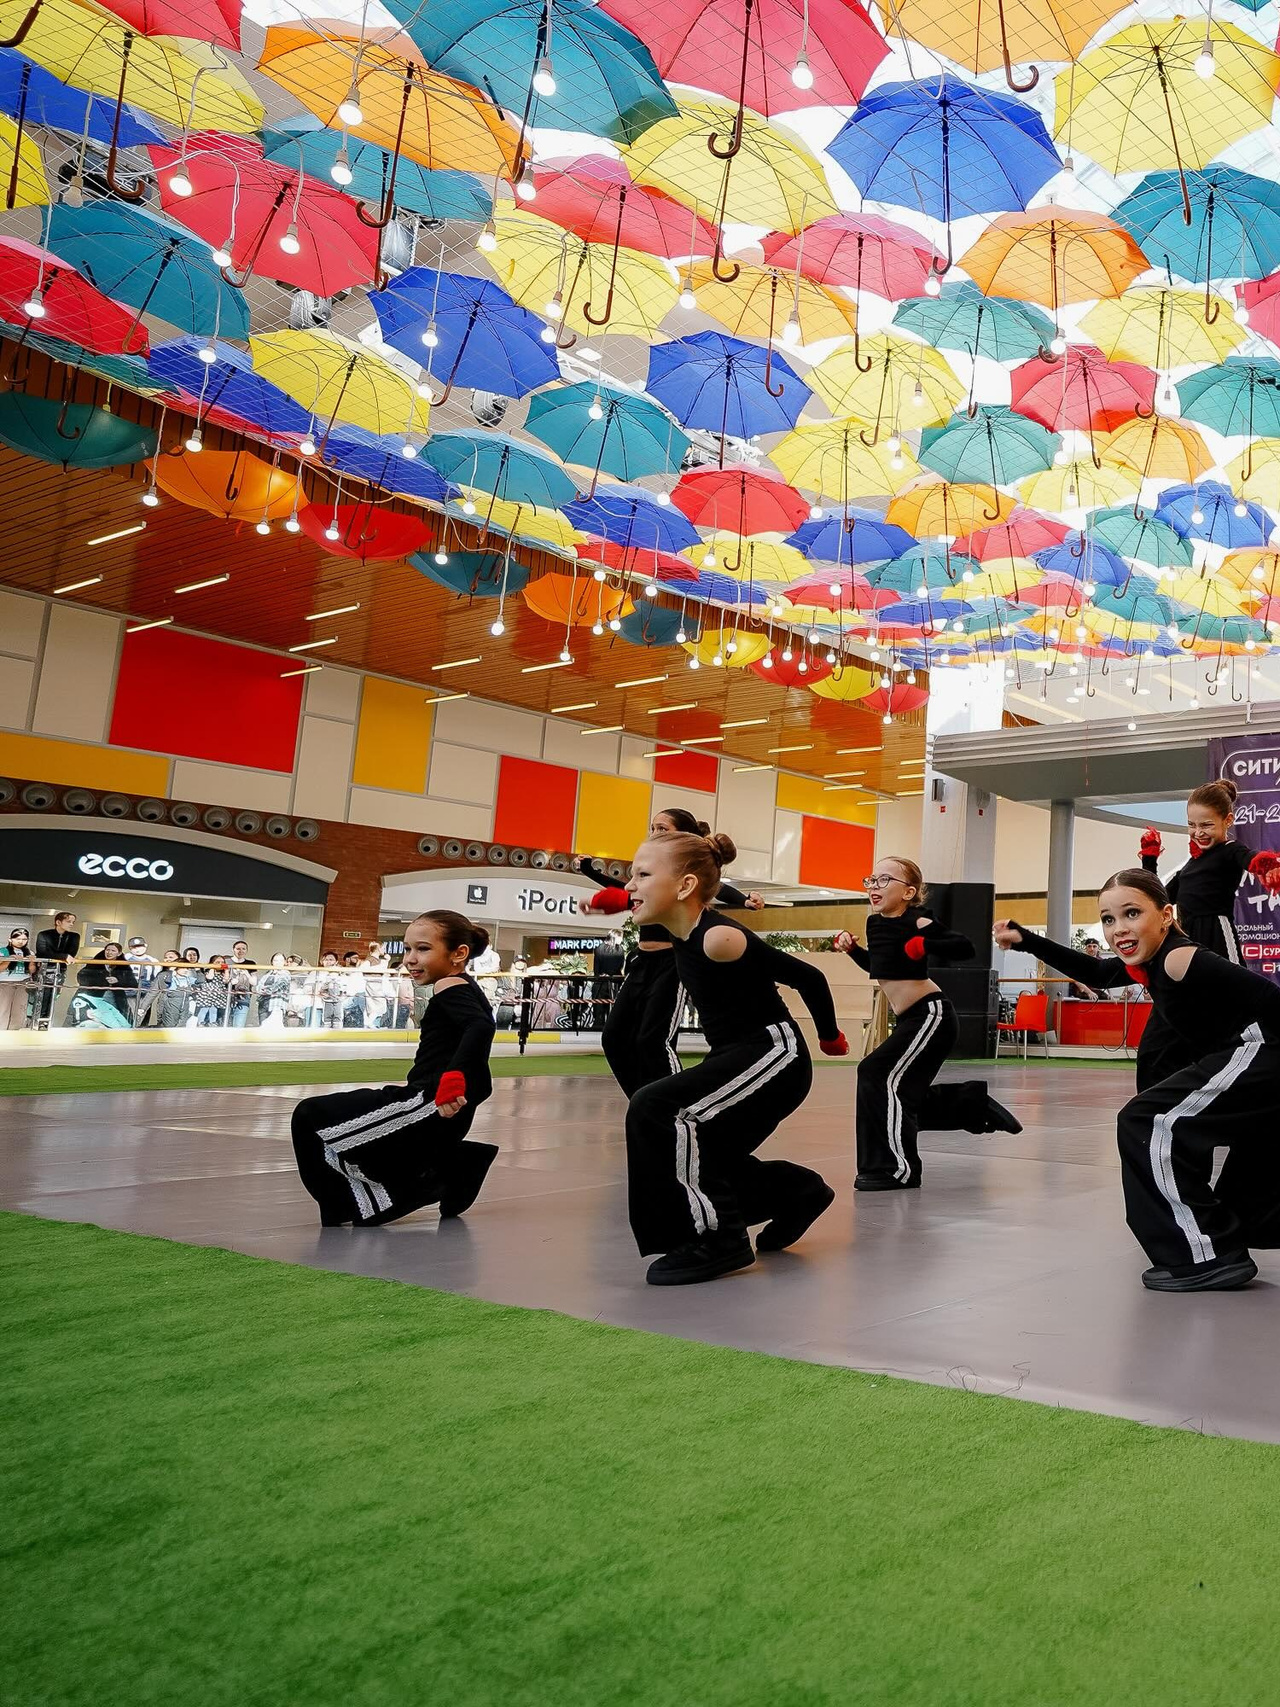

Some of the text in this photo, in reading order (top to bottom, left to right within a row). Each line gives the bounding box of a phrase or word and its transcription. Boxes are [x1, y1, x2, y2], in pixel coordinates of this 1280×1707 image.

[78, 853, 174, 881] ecco
[517, 889, 578, 915] iPort
[1235, 921, 1274, 933] ральный
[554, 939, 603, 950] MARK FOR
